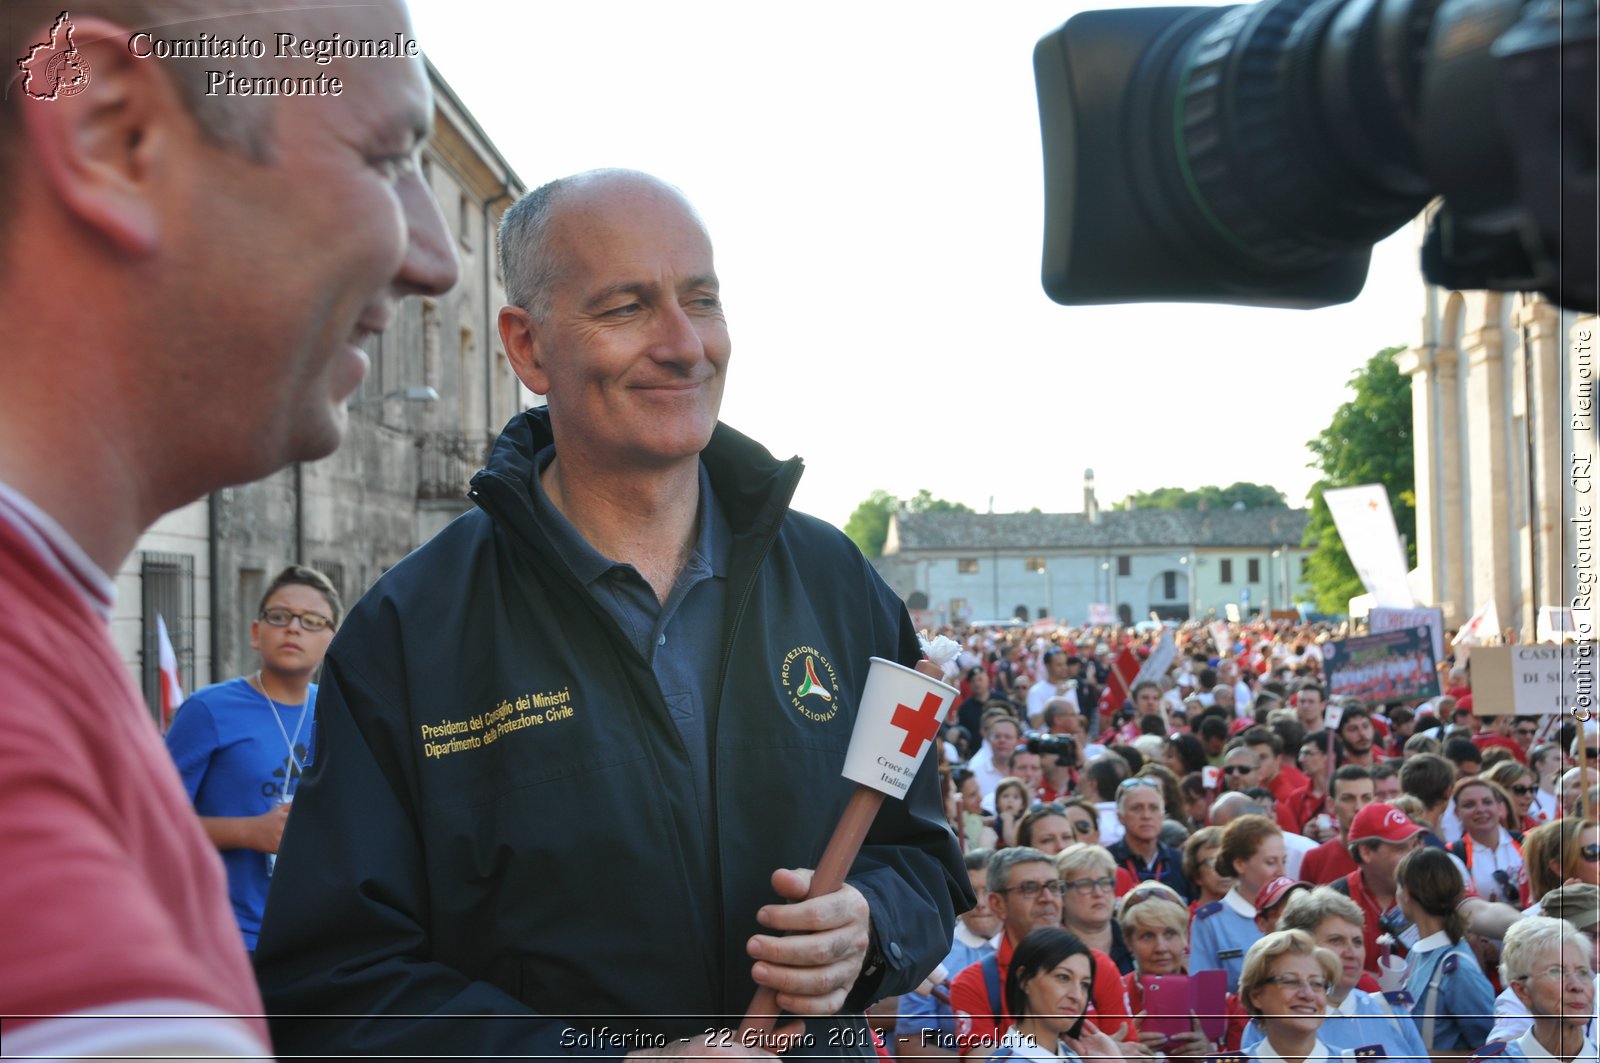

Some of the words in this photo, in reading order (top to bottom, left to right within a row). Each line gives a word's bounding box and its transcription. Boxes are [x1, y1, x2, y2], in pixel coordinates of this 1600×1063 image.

[781, 645, 820, 686] PROTEZIONE
[820, 656, 839, 692] CIVILE
[1523, 672, 1539, 684] DI
[421, 719, 469, 740] Presidenza
[469, 714, 484, 731] del
[484, 699, 514, 726] Consiglio
[515, 693, 531, 712] dei
[532, 686, 571, 709] Ministri
[791, 697, 838, 722] NAZIONALE
[424, 736, 481, 760] Dipartimento
[497, 712, 544, 737] Protezione
[545, 704, 574, 722] Civile
[877, 756, 903, 773] Croce
